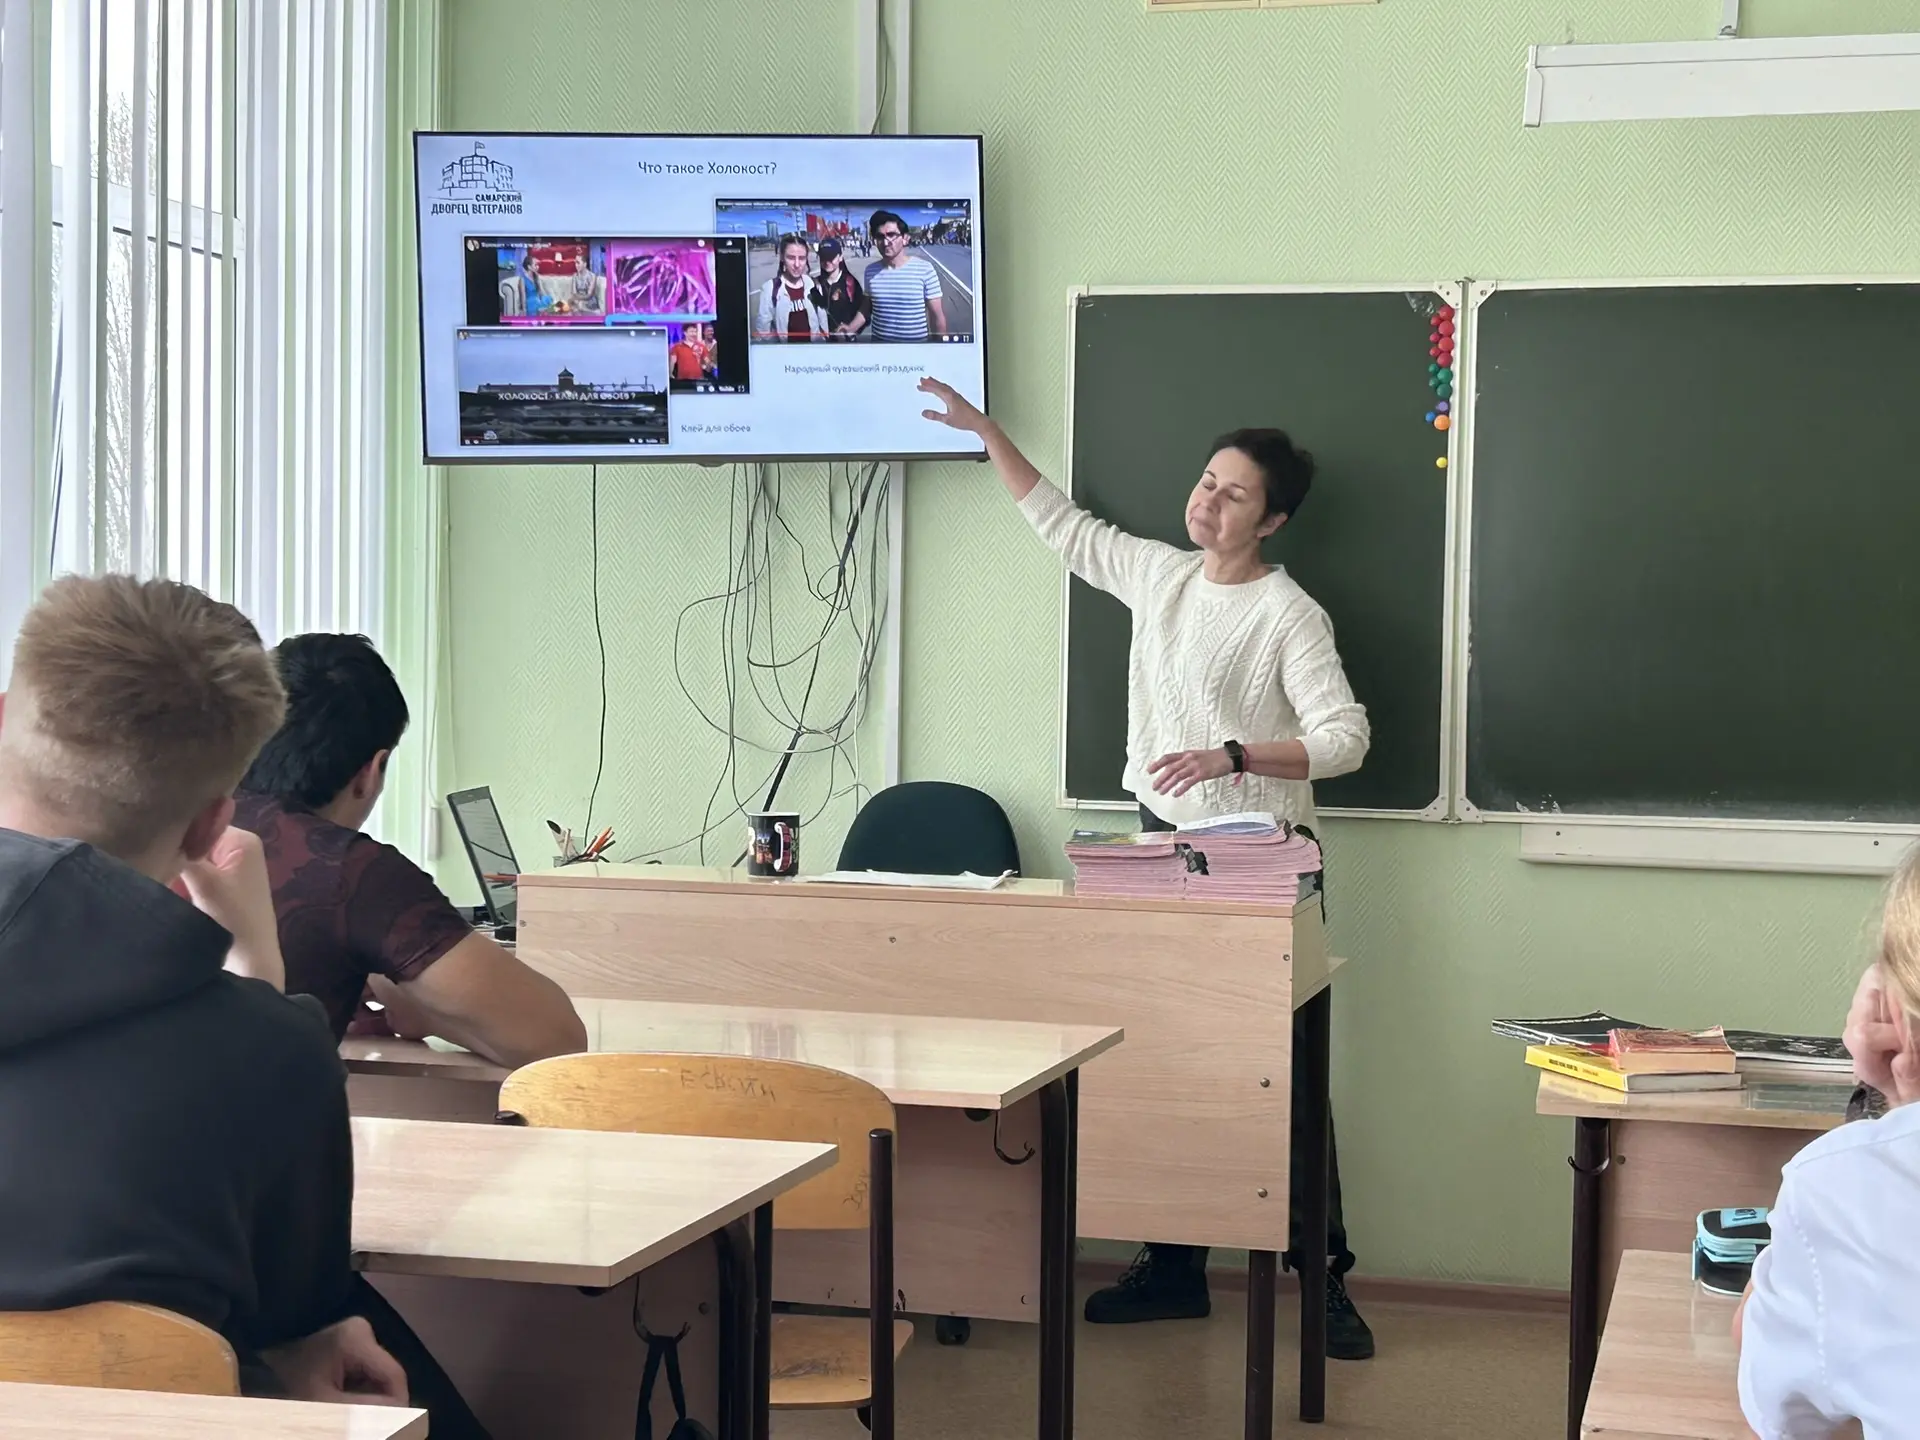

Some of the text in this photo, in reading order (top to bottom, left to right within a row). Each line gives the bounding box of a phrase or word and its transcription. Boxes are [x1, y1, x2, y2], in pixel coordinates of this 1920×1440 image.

[638, 161, 777, 175] Что такое Холокост?
[475, 192, 523, 202] САМАРСКИЙ
[431, 203, 523, 216] ДВОРЕЦ ВЕТЕРАНОВ
